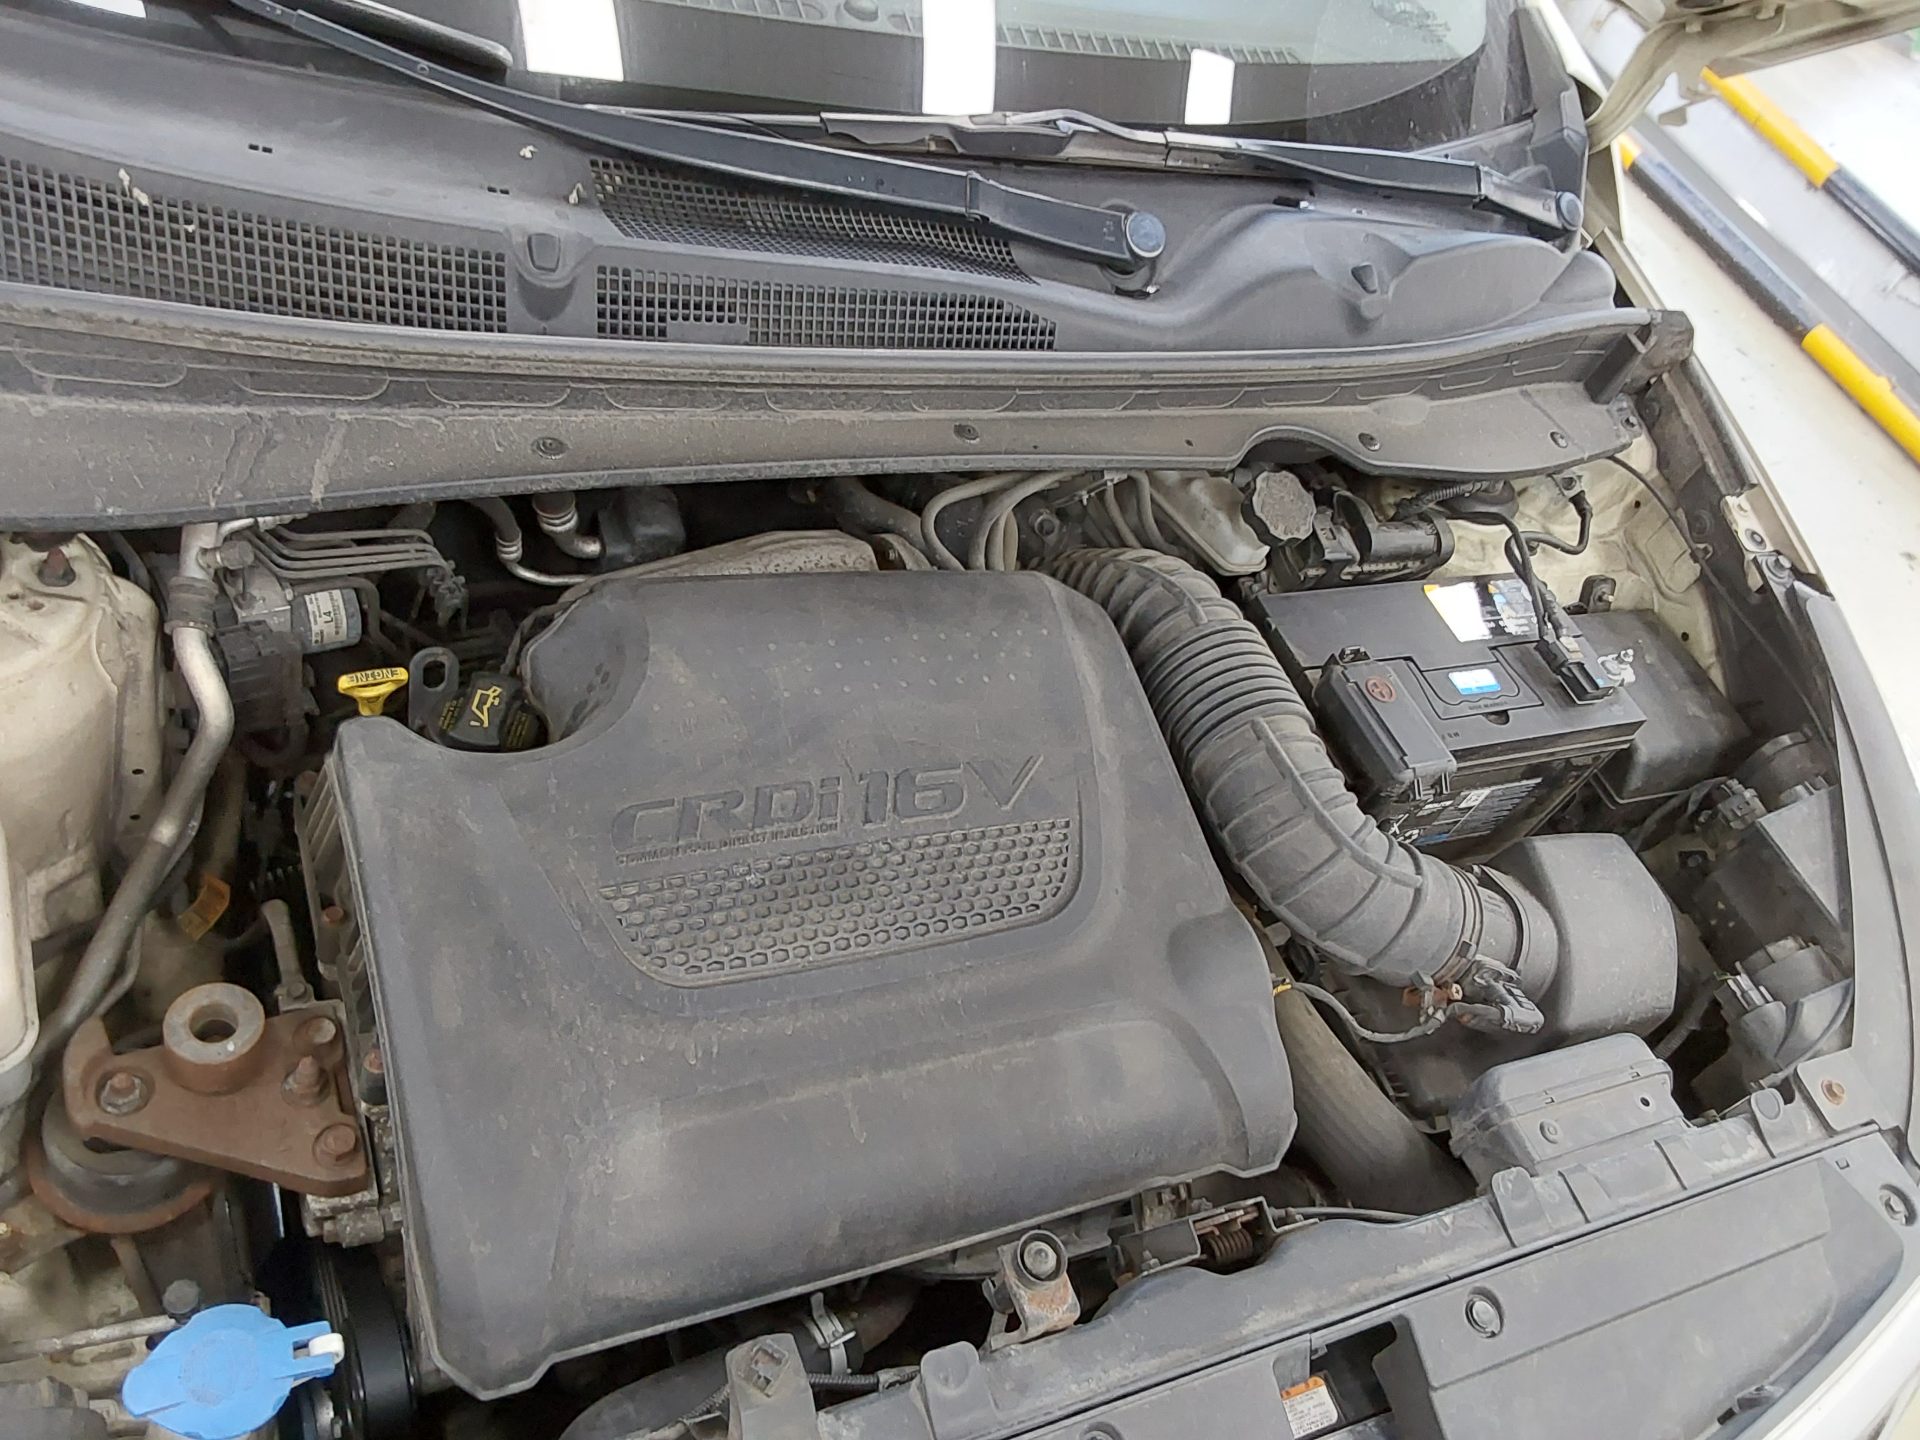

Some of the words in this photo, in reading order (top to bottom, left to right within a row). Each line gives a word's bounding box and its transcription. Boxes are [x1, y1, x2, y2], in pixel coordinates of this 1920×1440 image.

[347, 669, 400, 684] ENGINE
[611, 776, 841, 853] CRDi
[858, 754, 1044, 828] 16V
